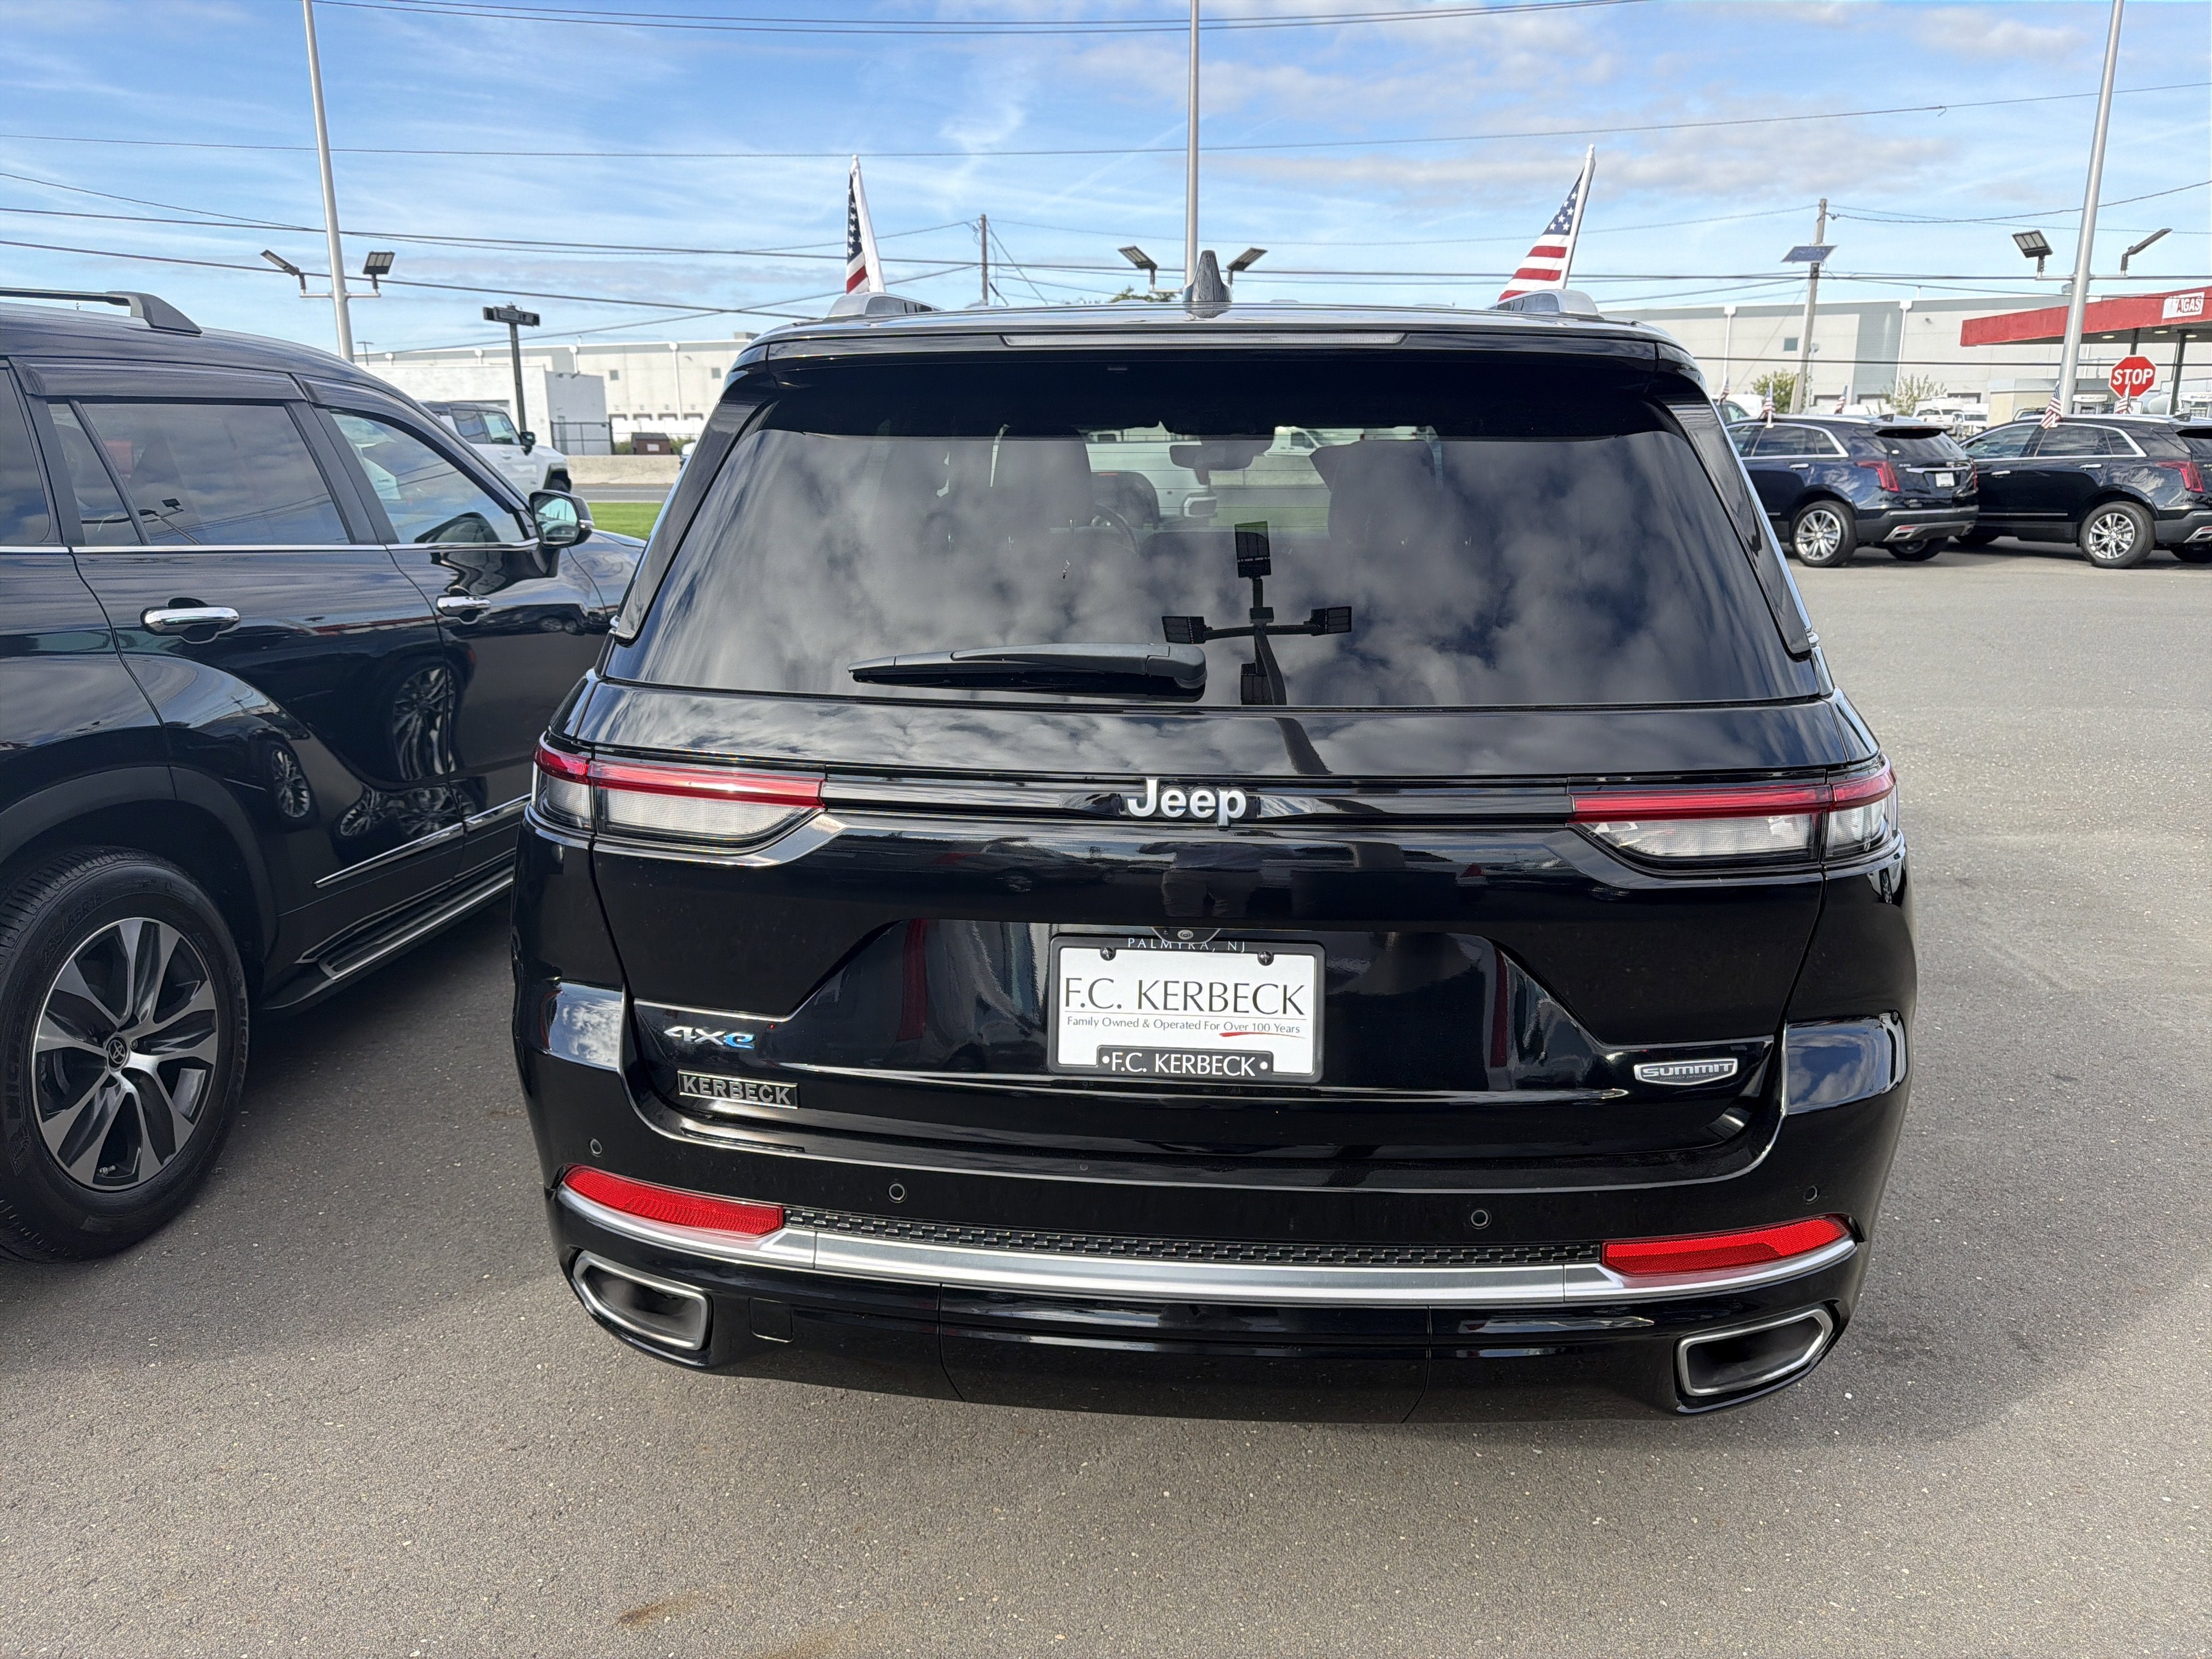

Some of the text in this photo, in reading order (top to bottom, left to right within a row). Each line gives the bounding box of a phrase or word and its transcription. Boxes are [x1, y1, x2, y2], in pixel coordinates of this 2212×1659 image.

[2112, 368, 2153, 385] STOP
[1127, 778, 1246, 827] Jeep
[1228, 940, 1245, 953] NJ
[1065, 977, 1305, 1015] F.C. KERBECK
[1067, 1016, 1300, 1034] Family Owned & Operated For Over 100 Years
[1111, 1052, 1256, 1077] F.C. KERBECK
[1643, 1063, 1733, 1077] SUMMIT
[682, 1075, 791, 1105] KERBECK
